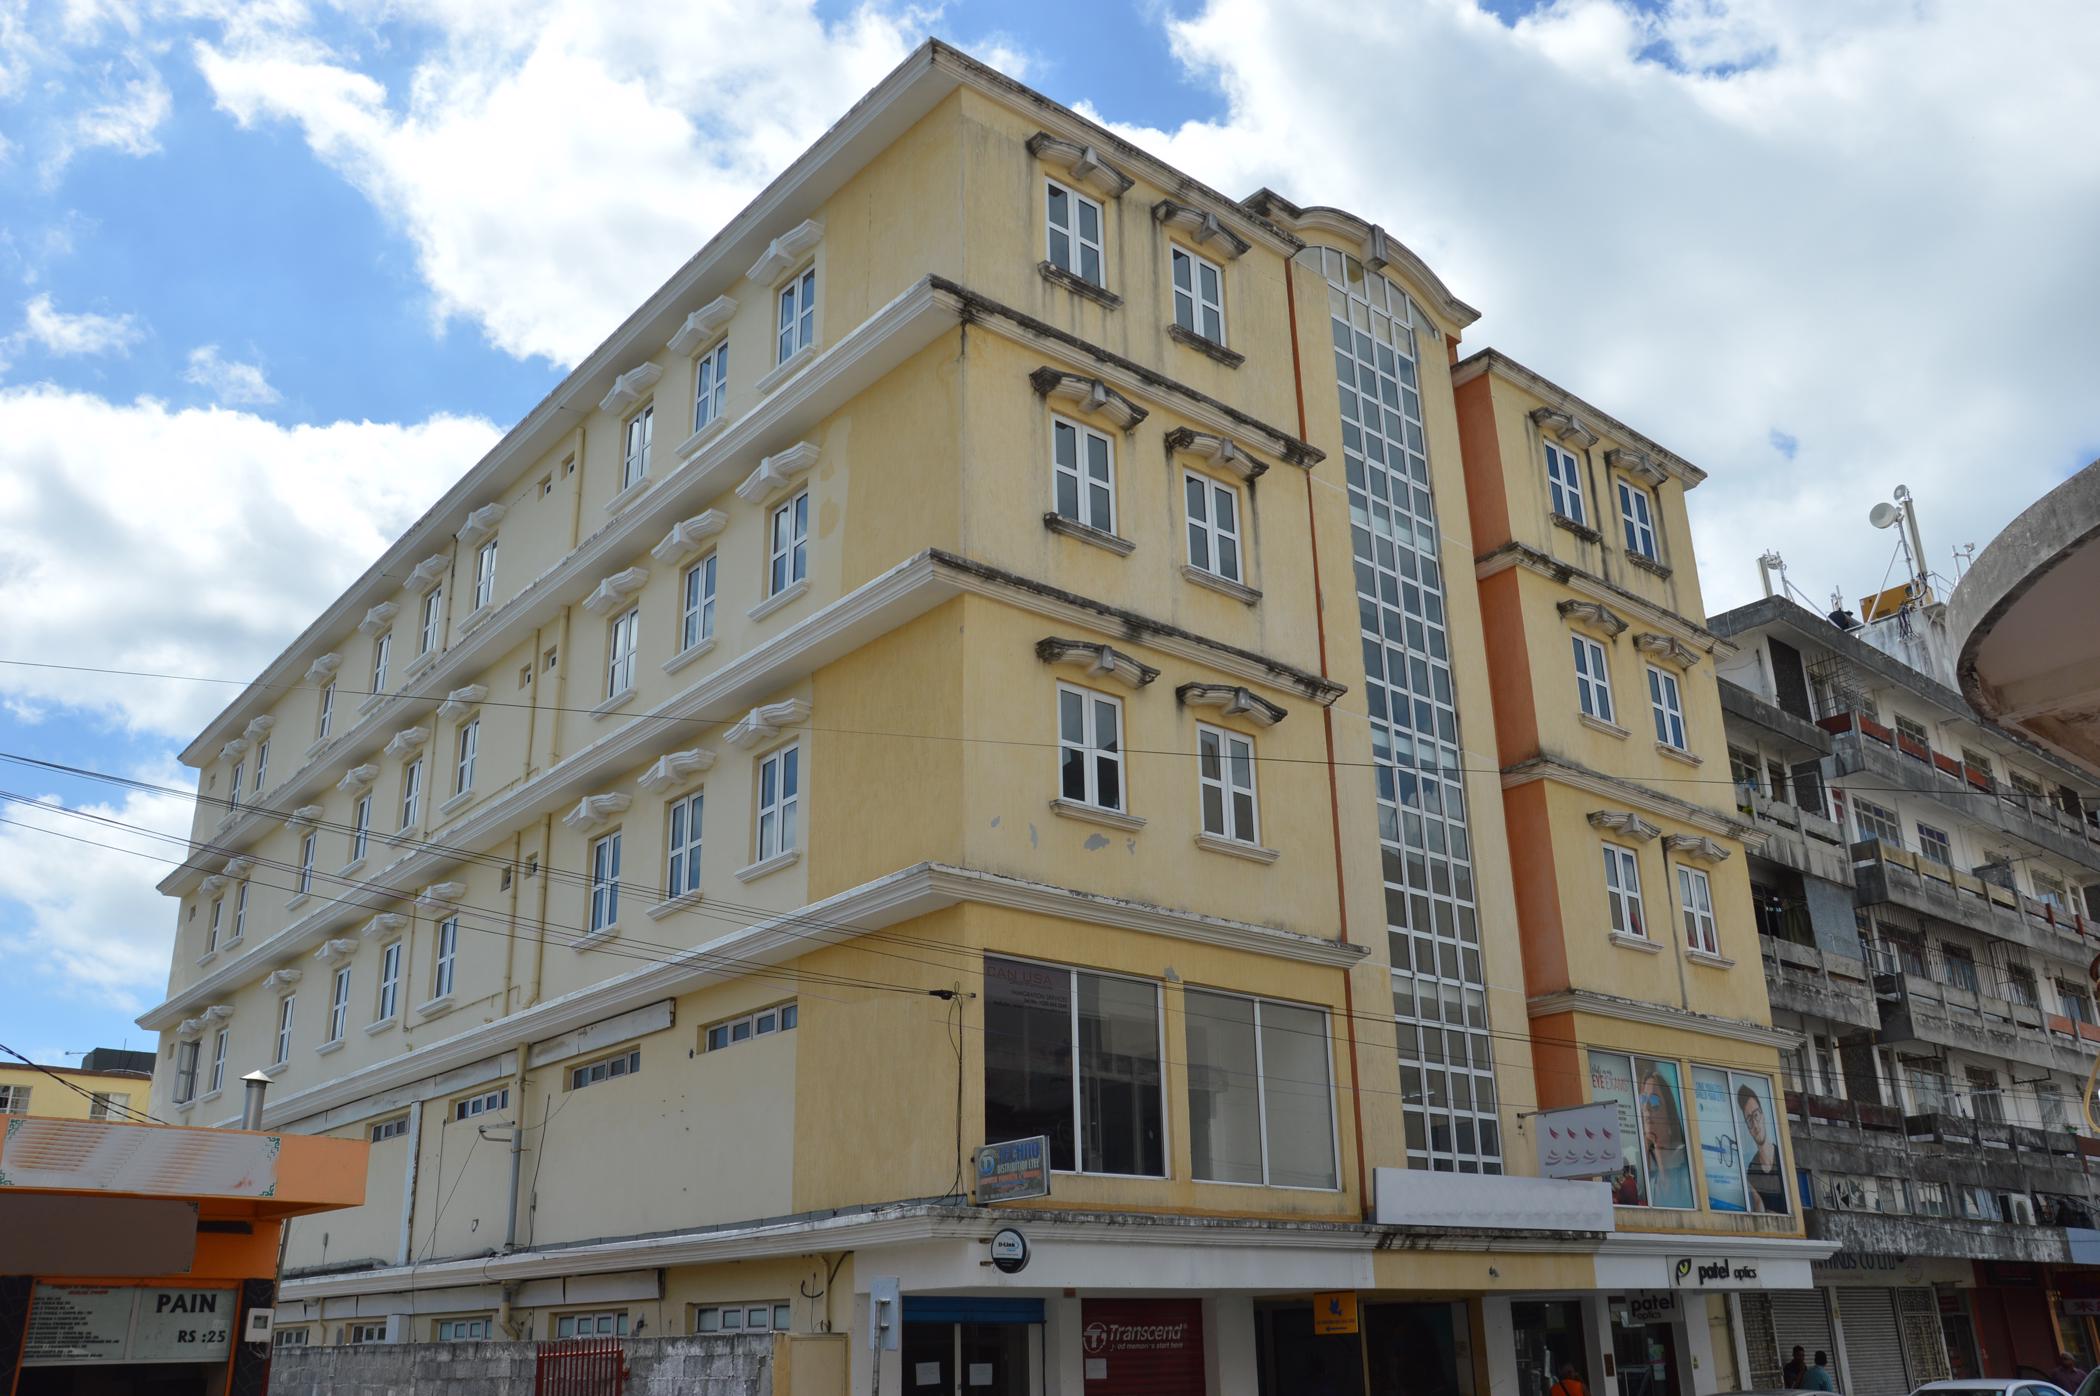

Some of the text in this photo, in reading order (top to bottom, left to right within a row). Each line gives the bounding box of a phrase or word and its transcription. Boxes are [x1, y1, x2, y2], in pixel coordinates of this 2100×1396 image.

[1023, 970, 1053, 985] USA
[1592, 1074, 1605, 1088] EYE
[1698, 1258, 1757, 1285] patel optics
[156, 1293, 217, 1313] PAIN
[1631, 1291, 1674, 1317] patel
[1637, 1310, 1662, 1320] optics
[177, 1329, 197, 1343] RS
[1109, 1324, 1183, 1341] Transcend
